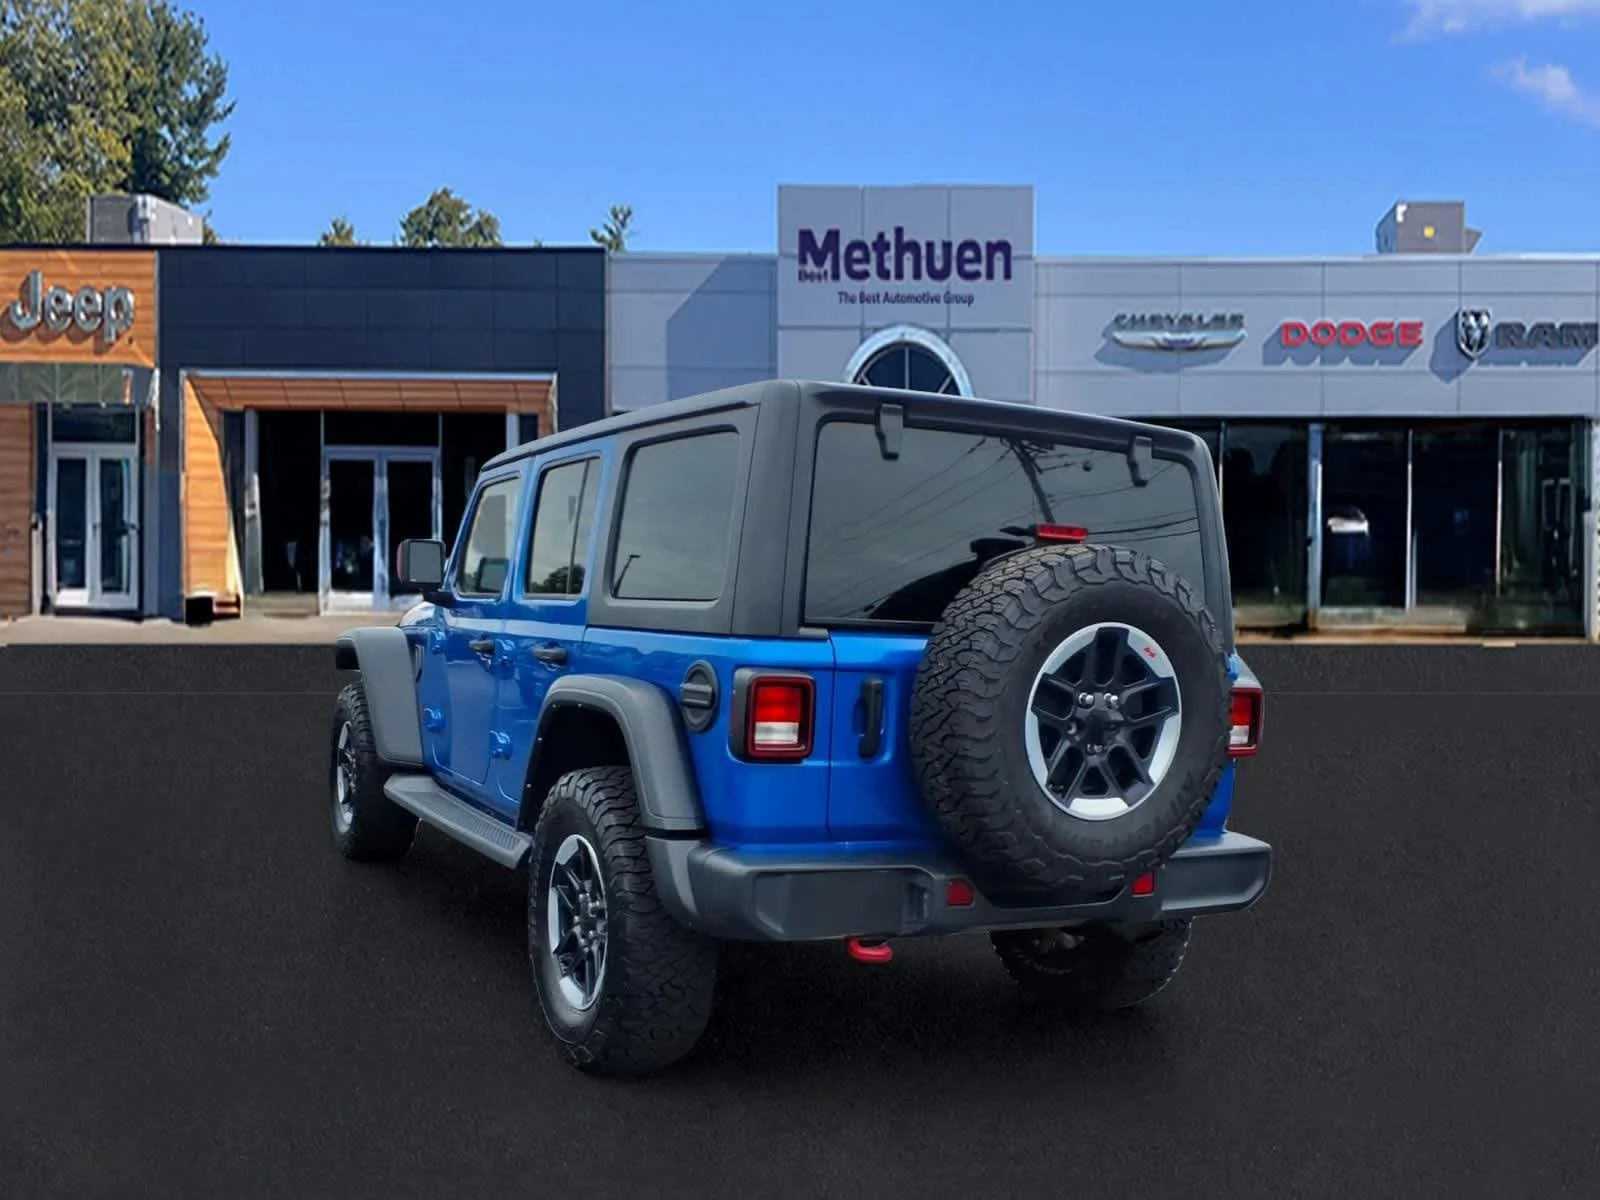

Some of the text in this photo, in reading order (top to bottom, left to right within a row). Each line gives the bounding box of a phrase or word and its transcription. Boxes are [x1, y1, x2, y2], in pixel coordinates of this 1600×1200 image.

[798, 226, 1012, 281] Methuen
[9, 269, 135, 343] Jeep
[838, 291, 974, 307] The Best Automotive Group
[1281, 321, 1424, 346] DODGE
[1494, 322, 1599, 350] RAM
